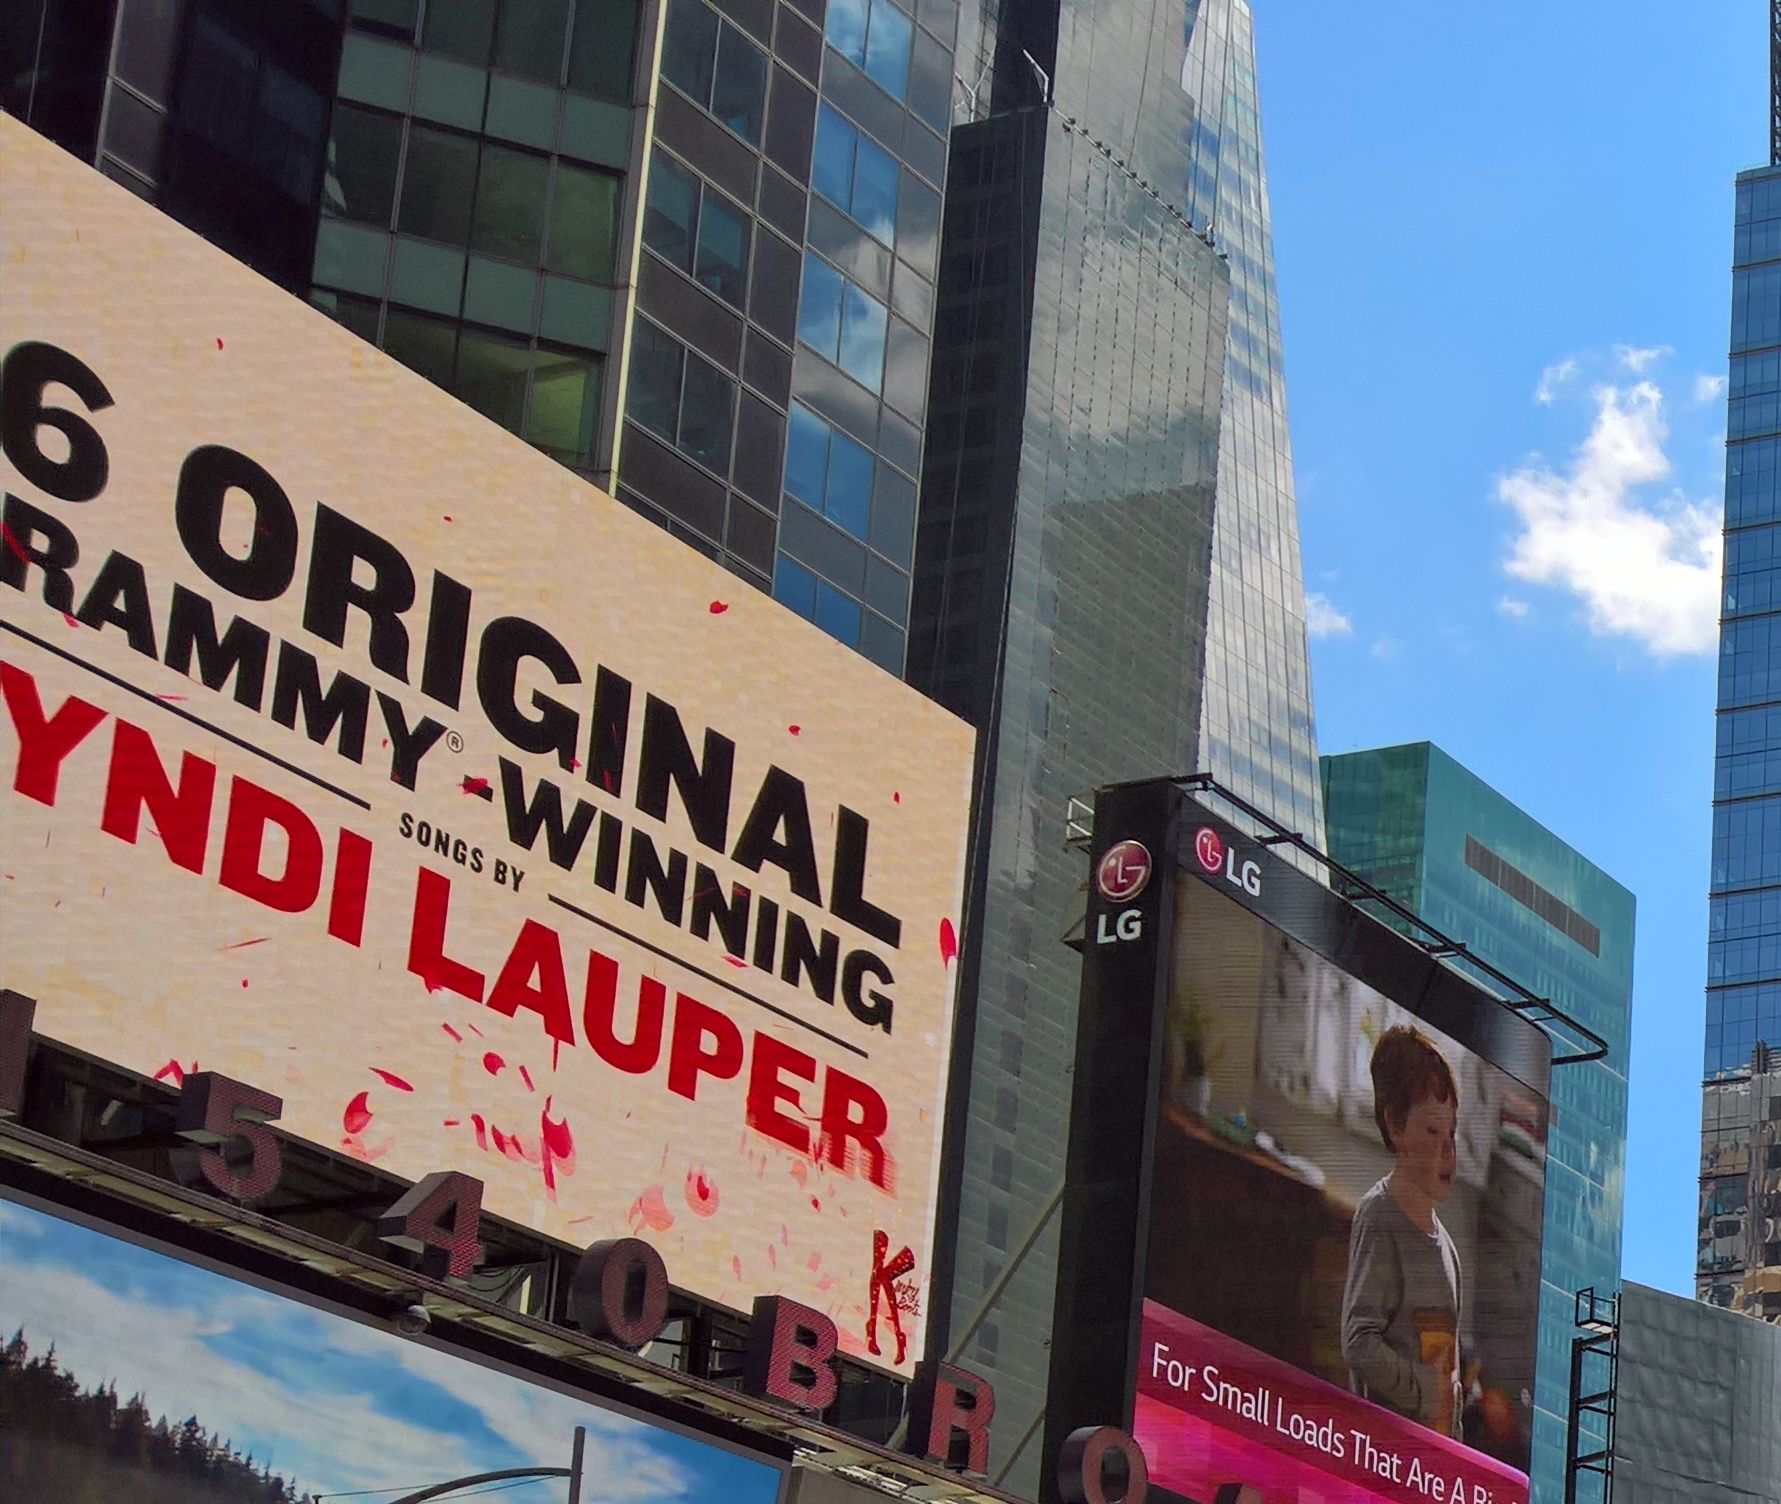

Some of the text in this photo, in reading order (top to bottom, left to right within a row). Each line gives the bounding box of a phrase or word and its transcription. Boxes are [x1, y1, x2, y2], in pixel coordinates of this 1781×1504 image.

[175, 444, 902, 949] ORIGINAL
[399, 812, 526, 894] SONGS BY
[1225, 856, 1262, 898] LG
[0, 660, 898, 1197] YNDI LAUPER
[1096, 909, 1142, 944] LG
[1152, 1342, 1192, 1394] For
[1201, 1365, 1270, 1428] Small
[1276, 1396, 1345, 1458] Loads
[1350, 1428, 1403, 1481] That
[1408, 1456, 1446, 1503] Are
